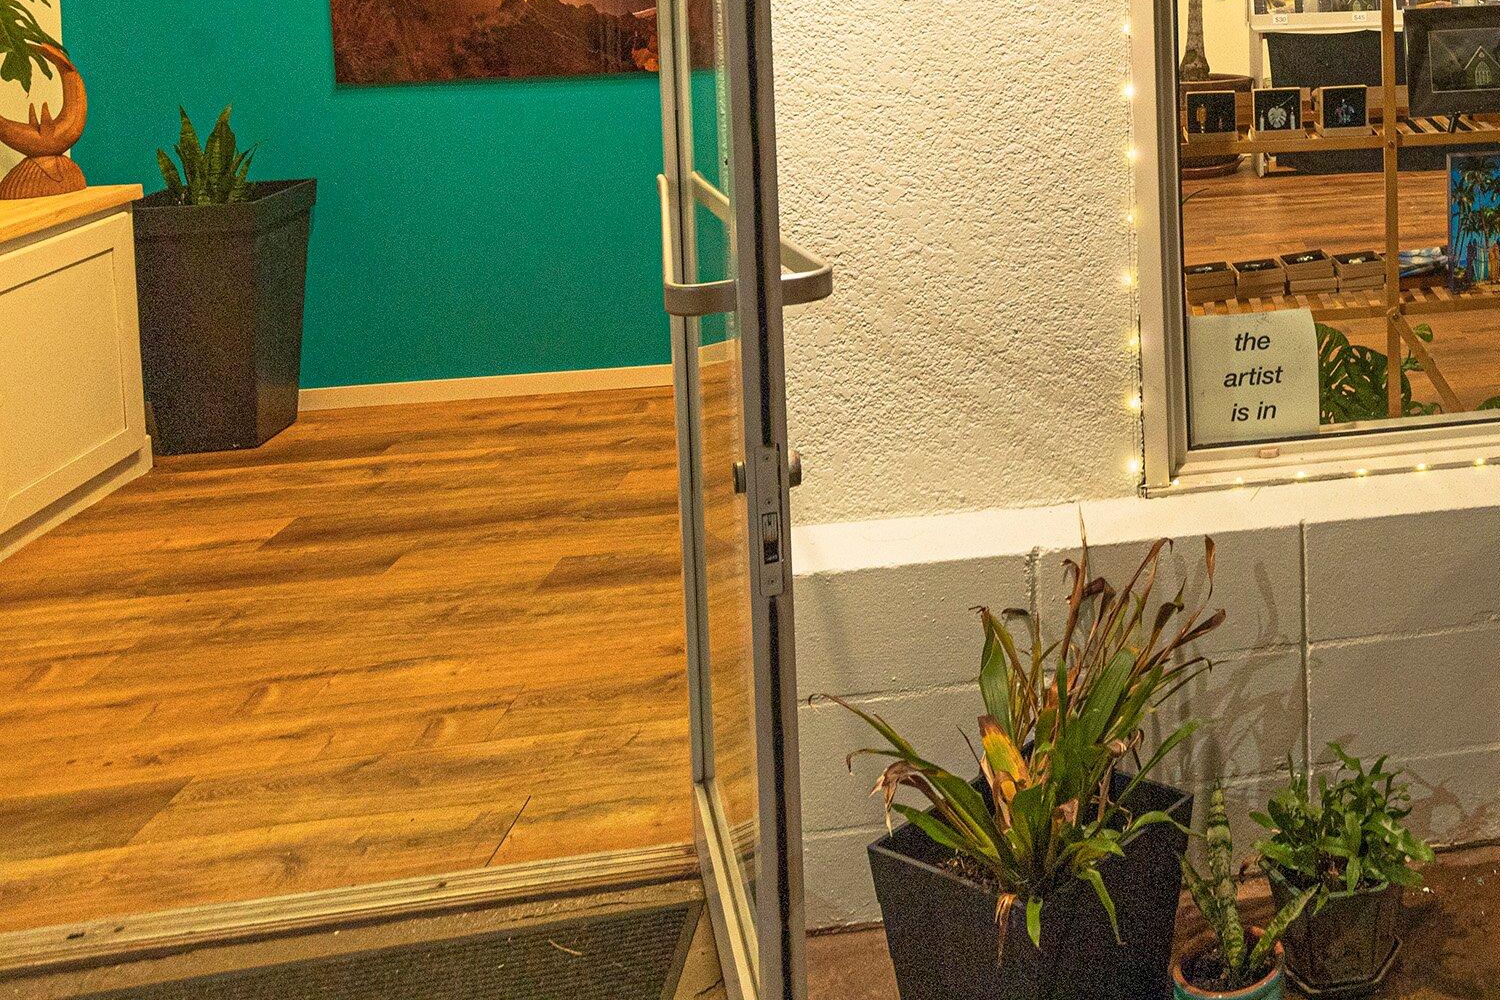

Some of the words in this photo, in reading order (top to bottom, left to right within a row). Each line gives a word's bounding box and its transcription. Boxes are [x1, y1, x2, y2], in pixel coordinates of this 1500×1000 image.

[1234, 332, 1271, 352] the
[1223, 365, 1284, 388] artist
[1231, 403, 1250, 422] is
[1256, 401, 1277, 420] in
